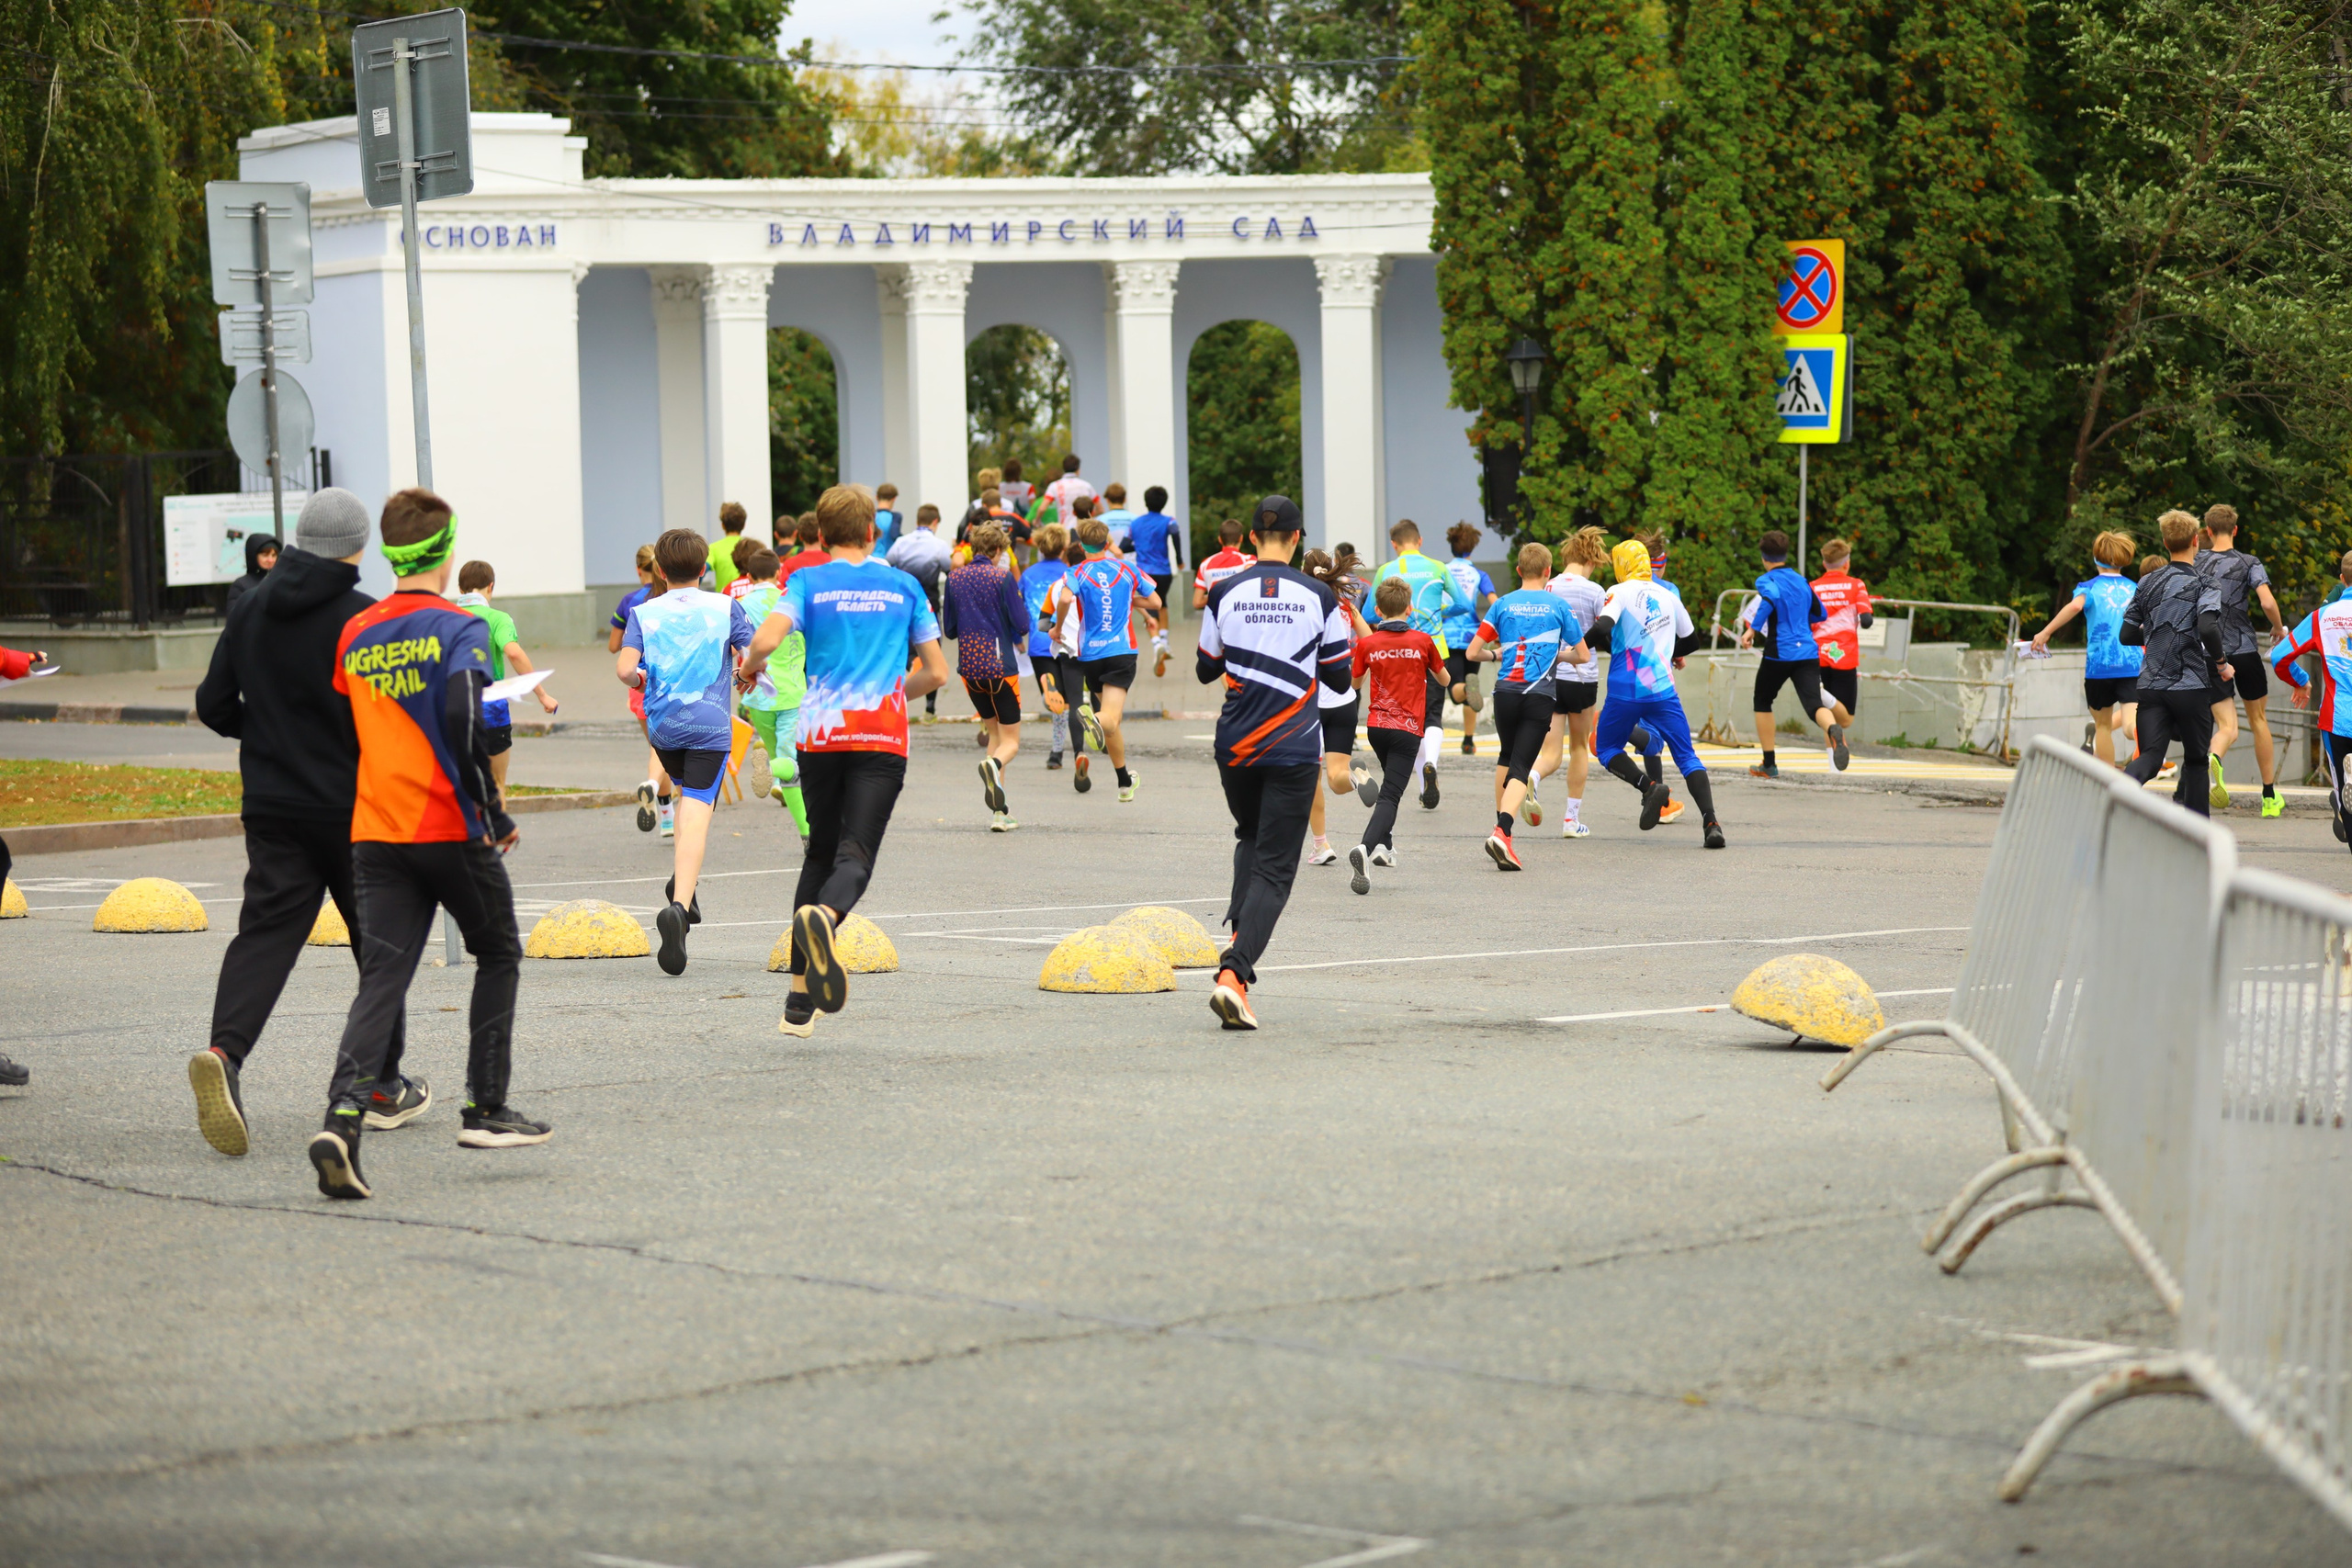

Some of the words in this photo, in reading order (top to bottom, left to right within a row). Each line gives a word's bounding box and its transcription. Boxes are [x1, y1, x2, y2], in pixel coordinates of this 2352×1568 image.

[770, 211, 1184, 244] ВЛАДИМИРСКИЙ
[1232, 217, 1318, 239] САД
[813, 590, 904, 604] ВОЛГОГРАДСКАЯ
[1097, 571, 1112, 631] ВОРОНЕЖ
[836, 600, 887, 612] ОБЛАСТЬ
[1234, 602, 1306, 613] Ивановская
[1245, 613, 1294, 624] область
[345, 636, 442, 675] UGRESHA
[1370, 649, 1420, 661] МОСКВА
[365, 668, 426, 701] TRAIL
